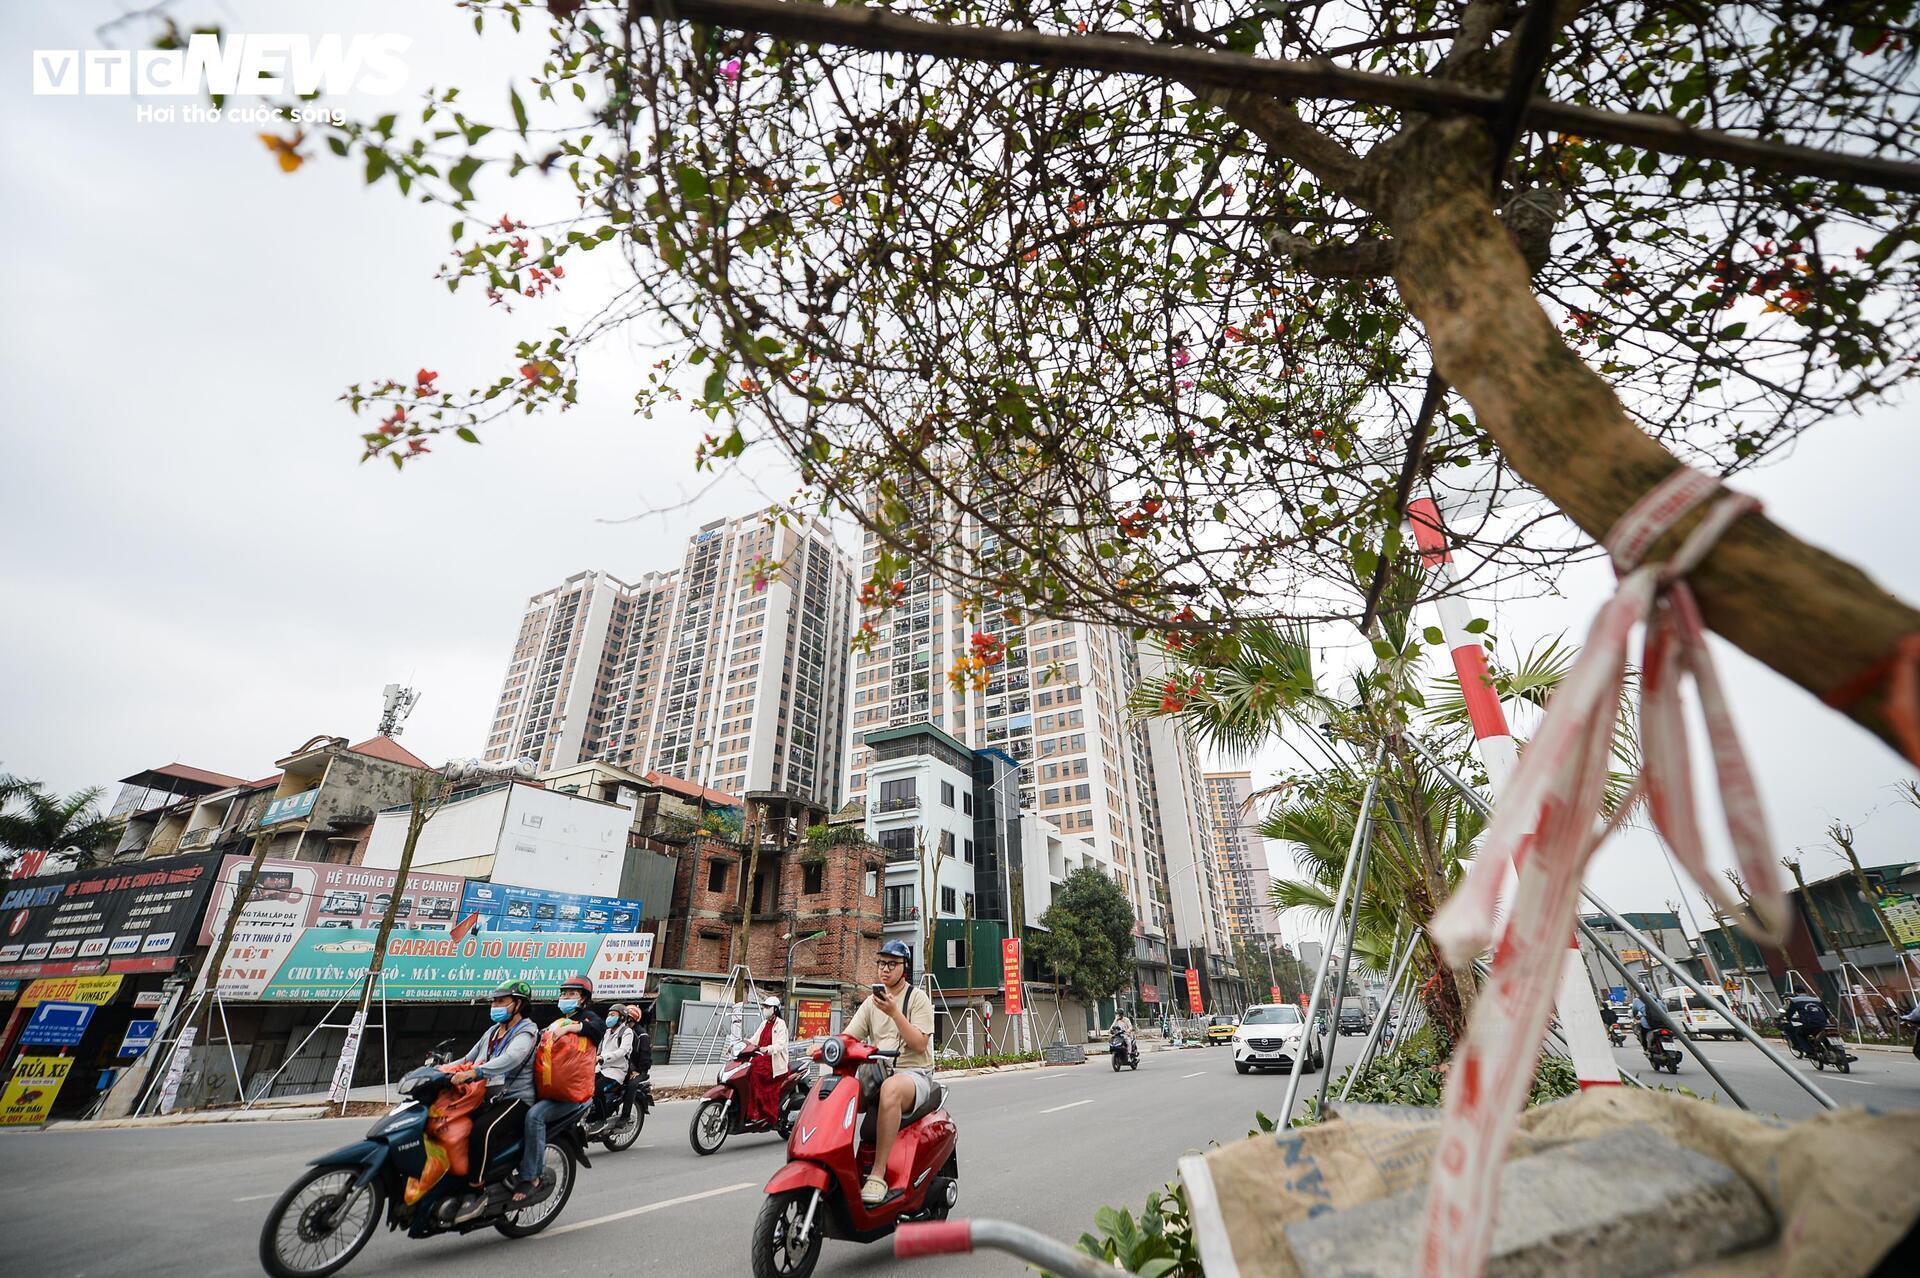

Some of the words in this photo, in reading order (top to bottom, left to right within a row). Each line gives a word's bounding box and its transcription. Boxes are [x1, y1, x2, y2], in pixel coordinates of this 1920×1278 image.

[79, 876, 105, 895] THỐNG
[118, 876, 132, 890] XE
[131, 869, 168, 888] CHUYÊN
[326, 869, 343, 886] HỆ
[346, 871, 384, 888] THỐNG
[407, 879, 419, 890] XE
[422, 879, 462, 893] CARNET
[252, 911, 269, 919] TÂM
[268, 911, 283, 920] LẮP
[241, 933, 252, 942] TY
[253, 933, 273, 943] TNHH
[274, 932, 281, 943] Ô
[282, 932, 292, 943] TÔ
[230, 945, 274, 962] IỆT
[388, 938, 460, 958] GARAGE
[463, 937, 478, 958] Ô
[481, 938, 505, 958] TÔ
[507, 937, 543, 962] VIỆT
[545, 939, 587, 959] BÌNH
[604, 950, 648, 965] VIỆT
[287, 963, 345, 981] CHUYÊN:
[410, 965, 440, 981] MÁY
[447, 963, 476, 981] GẦM
[483, 966, 512, 983] ĐIỆN
[519, 966, 548, 984] ĐIỆN
[599, 967, 645, 980] BÌNH
[289, 987, 299, 998] SỐ
[16, 1059, 46, 1077] RỬA
[47, 1063, 69, 1077] XE
